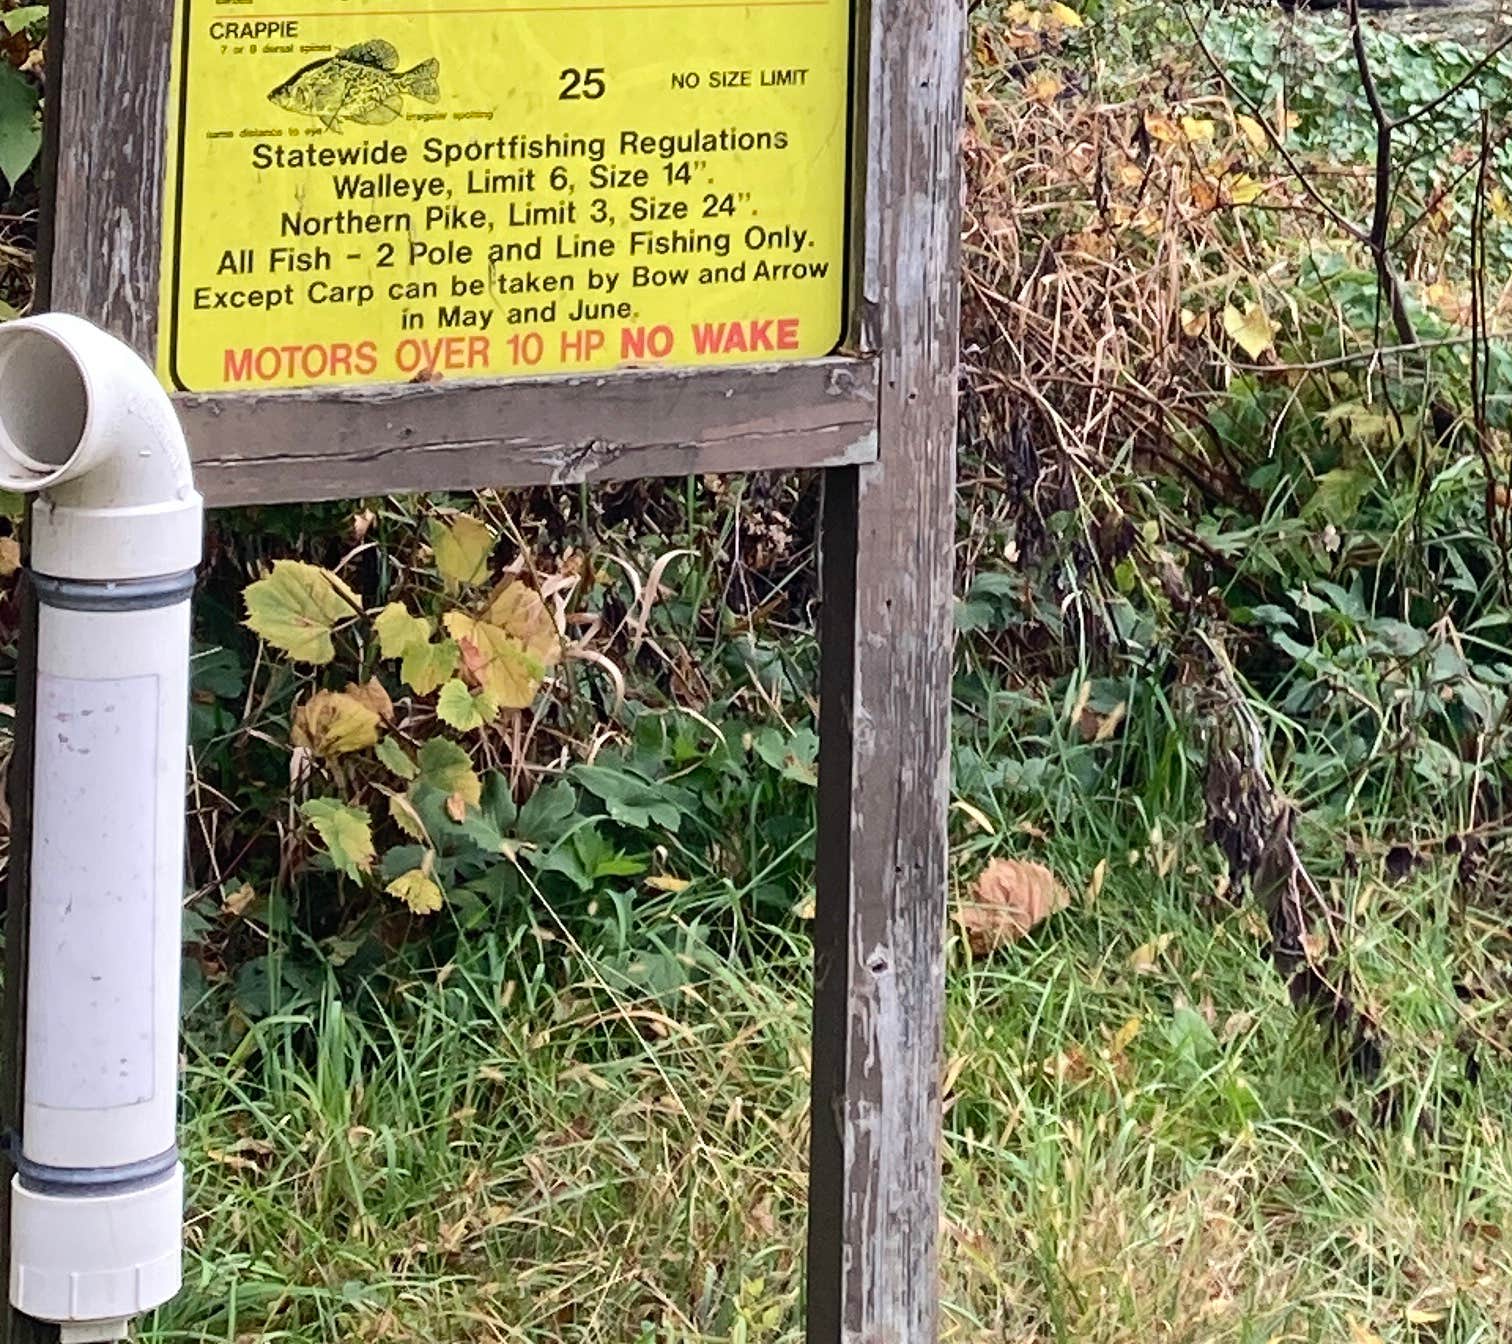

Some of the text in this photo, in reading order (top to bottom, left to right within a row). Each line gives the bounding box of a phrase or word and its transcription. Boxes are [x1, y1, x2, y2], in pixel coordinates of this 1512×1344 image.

[209, 21, 298, 40] CRAPPIE
[558, 68, 605, 100] 25
[671, 69, 809, 89] NO SIZE LIMIT
[252, 127, 788, 169] Statewide Sportfishing Regulations
[333, 174, 453, 201] Walleye,
[467, 166, 535, 194] Limit
[550, 166, 575, 195] 6,
[589, 164, 649, 189] Size
[281, 210, 411, 237] Northern
[426, 205, 495, 232] Pike,
[509, 199, 576, 226] Limit
[590, 198, 616, 227] 3,
[629, 195, 688, 222] Size
[216, 249, 254, 275] All
[269, 246, 331, 273] Fish
[376, 242, 395, 267] 2
[410, 241, 473, 266] Pole
[488, 236, 541, 262] and
[556, 234, 615, 259] Line
[630, 229, 730, 257] Fishing
[744, 225, 815, 252] Only.
[194, 261, 829, 311] Except Carp can be taken by Bow and Arrow
[401, 299, 640, 330] in May and June.
[223, 318, 800, 382] MOTORS OVER 10 HP NO WAKE
